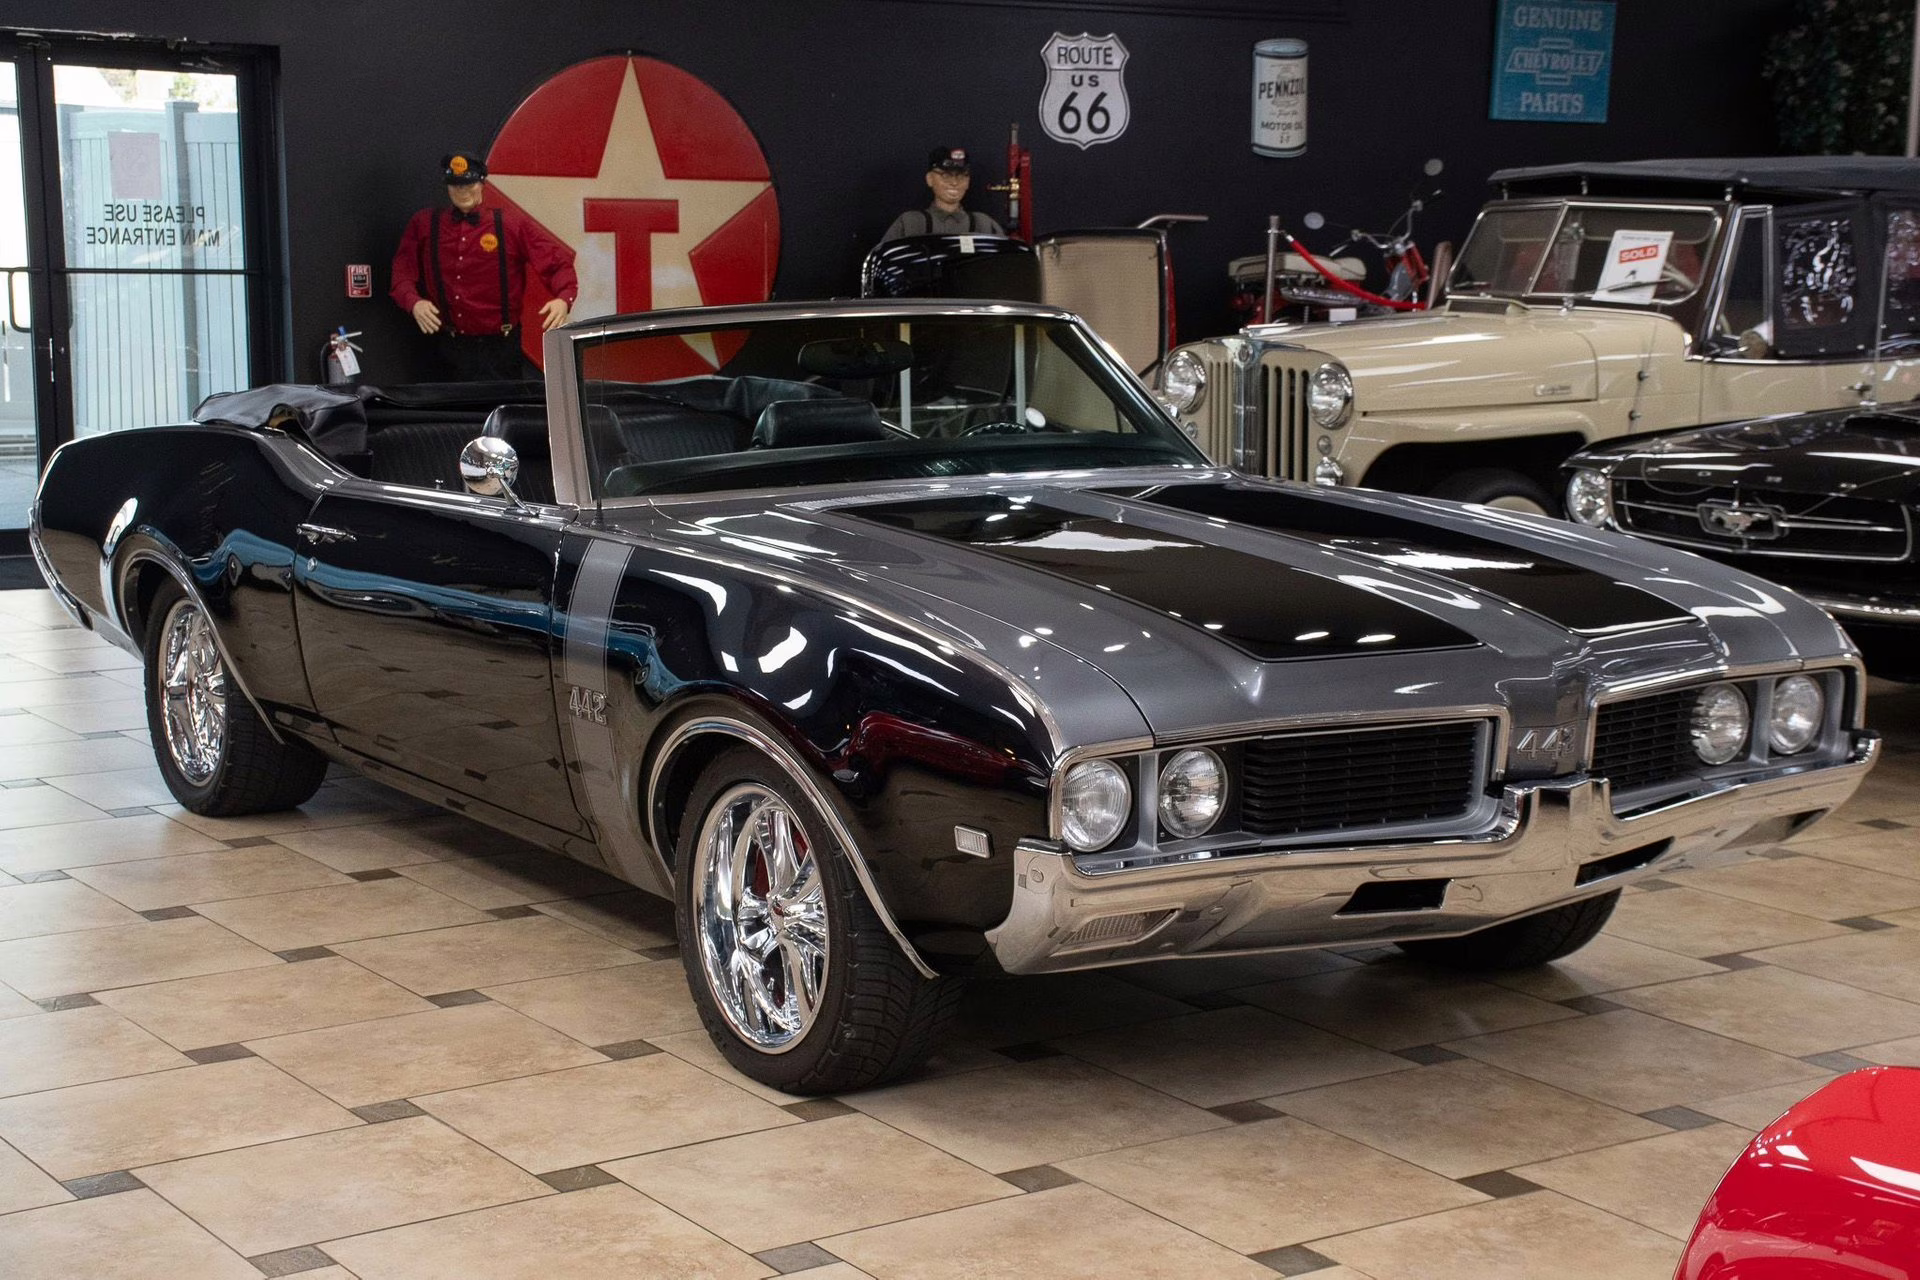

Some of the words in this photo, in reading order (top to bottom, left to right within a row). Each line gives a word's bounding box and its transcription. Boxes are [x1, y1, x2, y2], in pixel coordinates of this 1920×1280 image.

[1513, 6, 1603, 31] GENUINE
[1057, 46, 1113, 65] ROUTE
[1512, 51, 1598, 72] CHEVROLET
[1058, 91, 1111, 134] 66
[1520, 92, 1584, 114] PARTS
[1261, 121, 1292, 131] MOTOR
[582, 197, 680, 314] T
[1621, 247, 1658, 261] SOLD
[569, 686, 607, 725] 442
